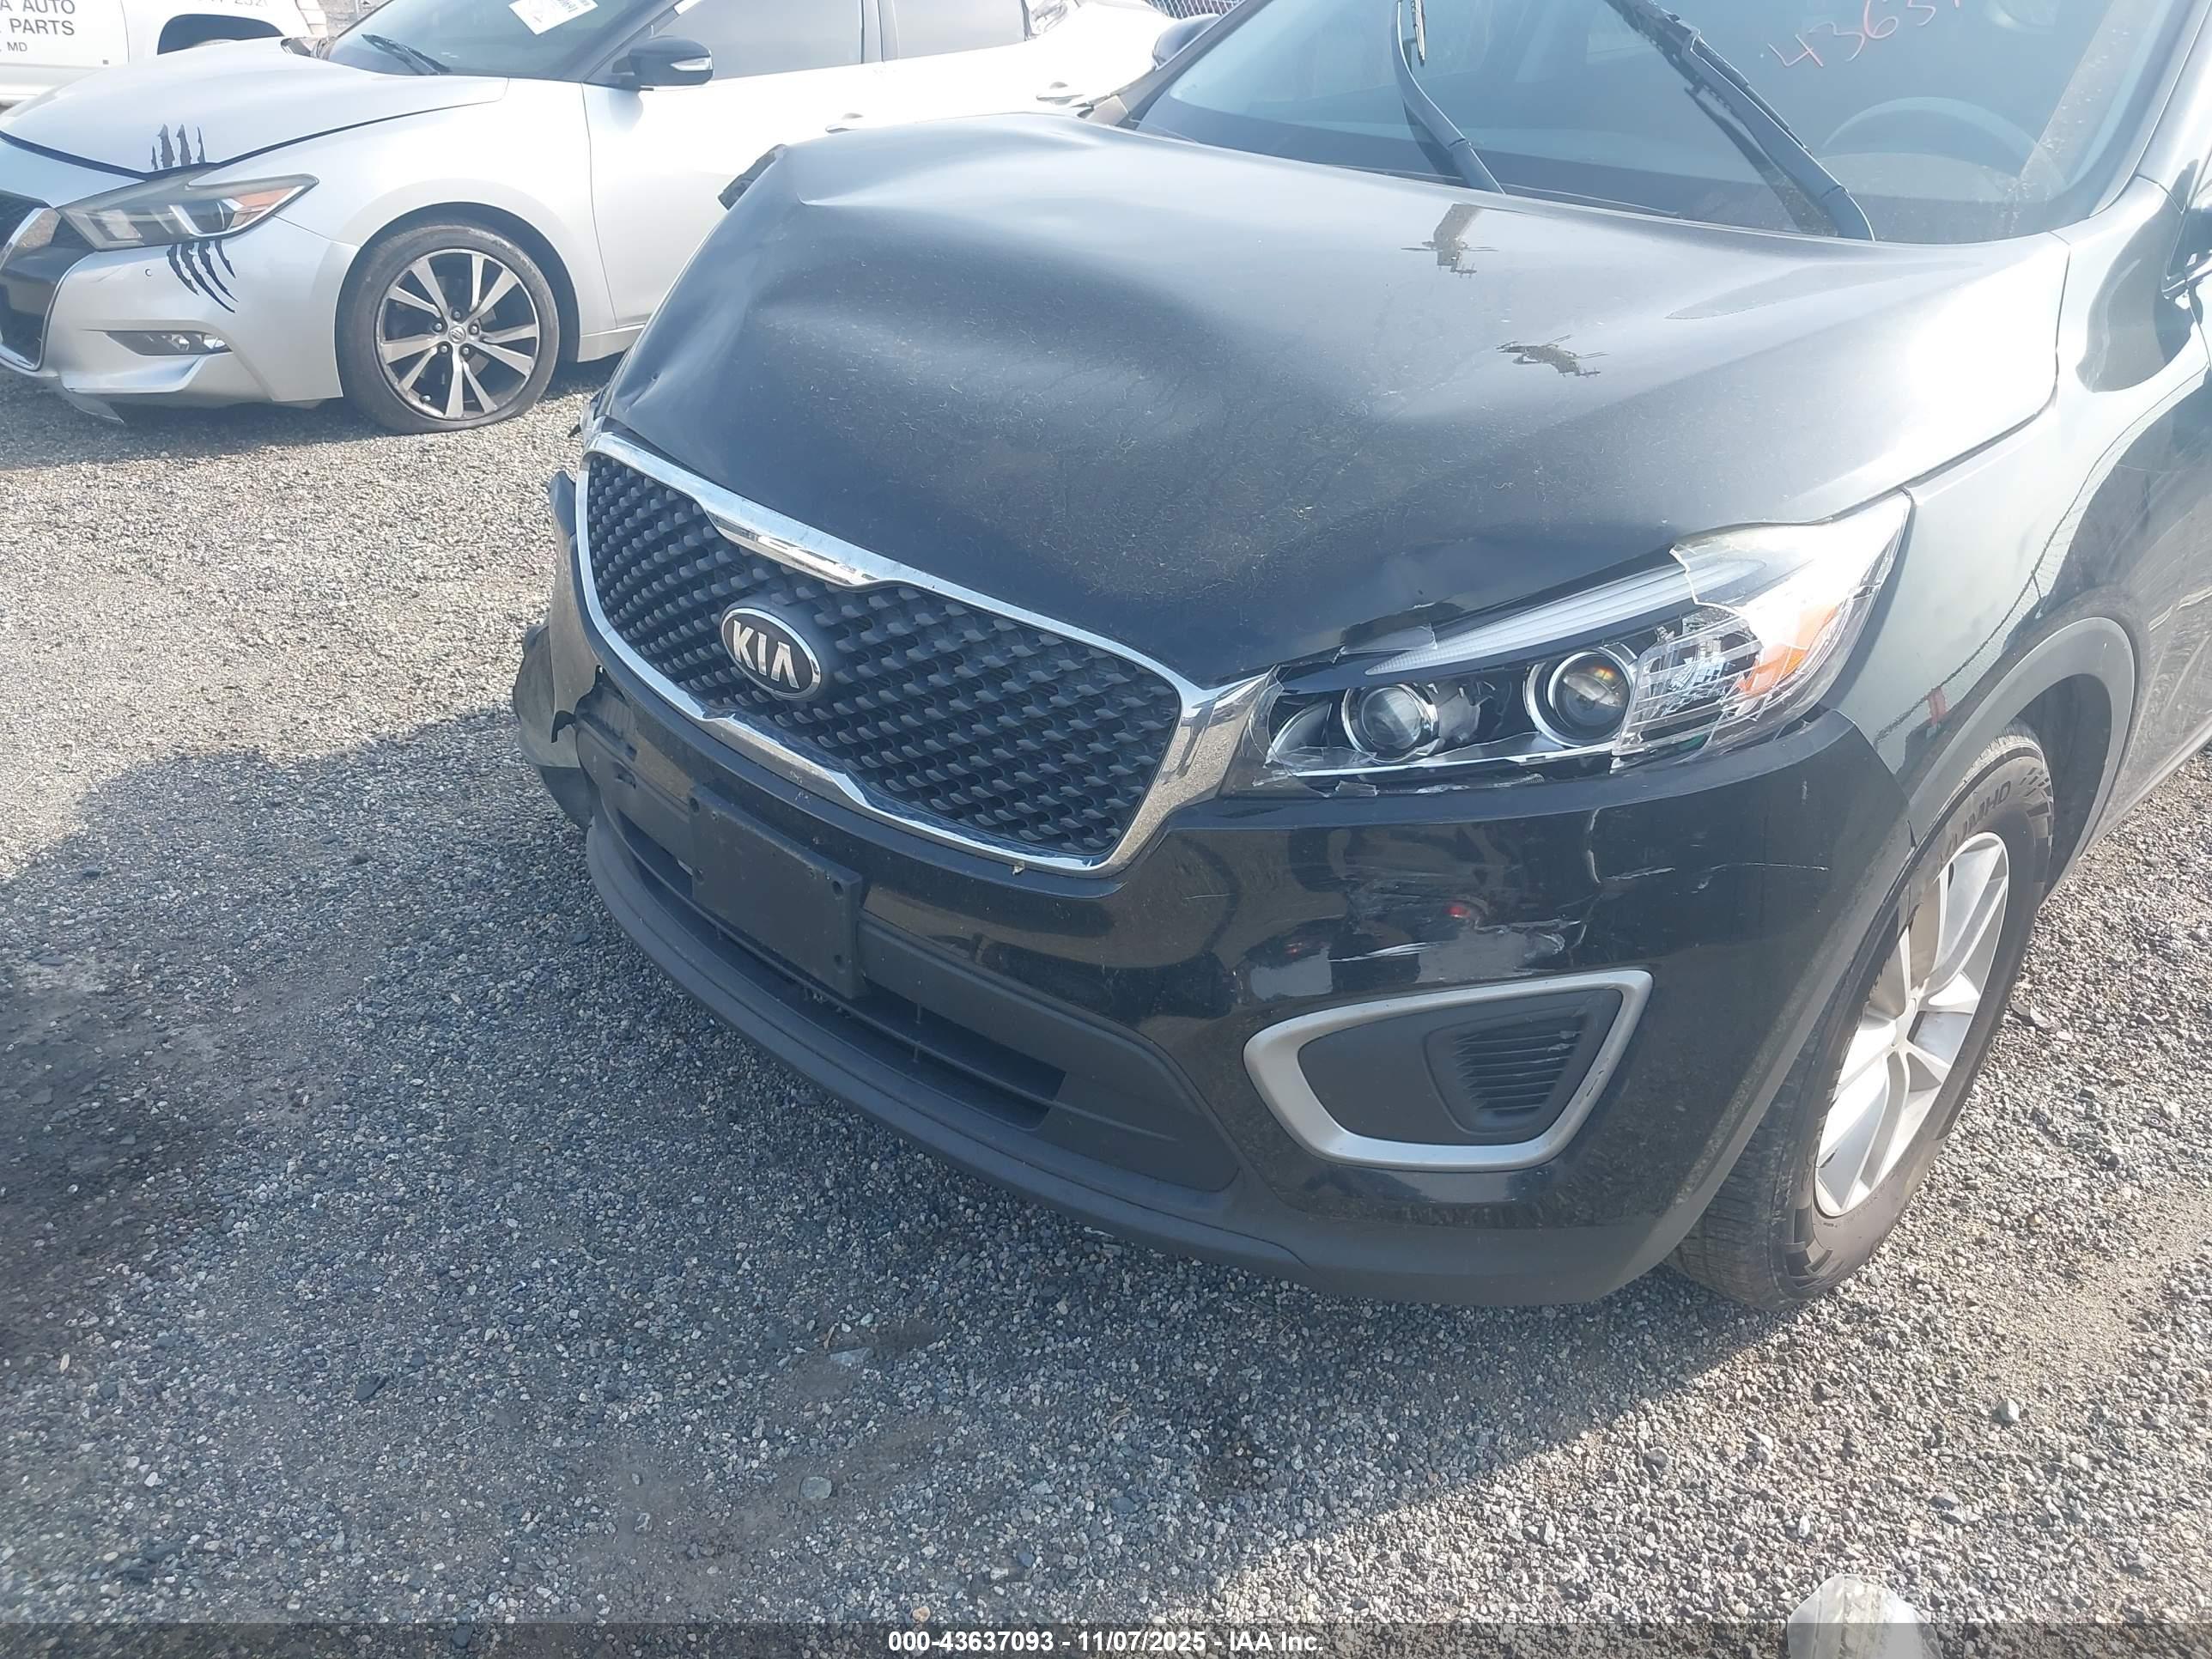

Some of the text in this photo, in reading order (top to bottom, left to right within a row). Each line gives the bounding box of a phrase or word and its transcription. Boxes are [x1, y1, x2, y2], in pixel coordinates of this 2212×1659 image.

[22, 0, 76, 14] AUTO
[9, 18, 75, 36] PARTS
[7, 41, 27, 52] MD
[732, 619, 800, 689] KIA
